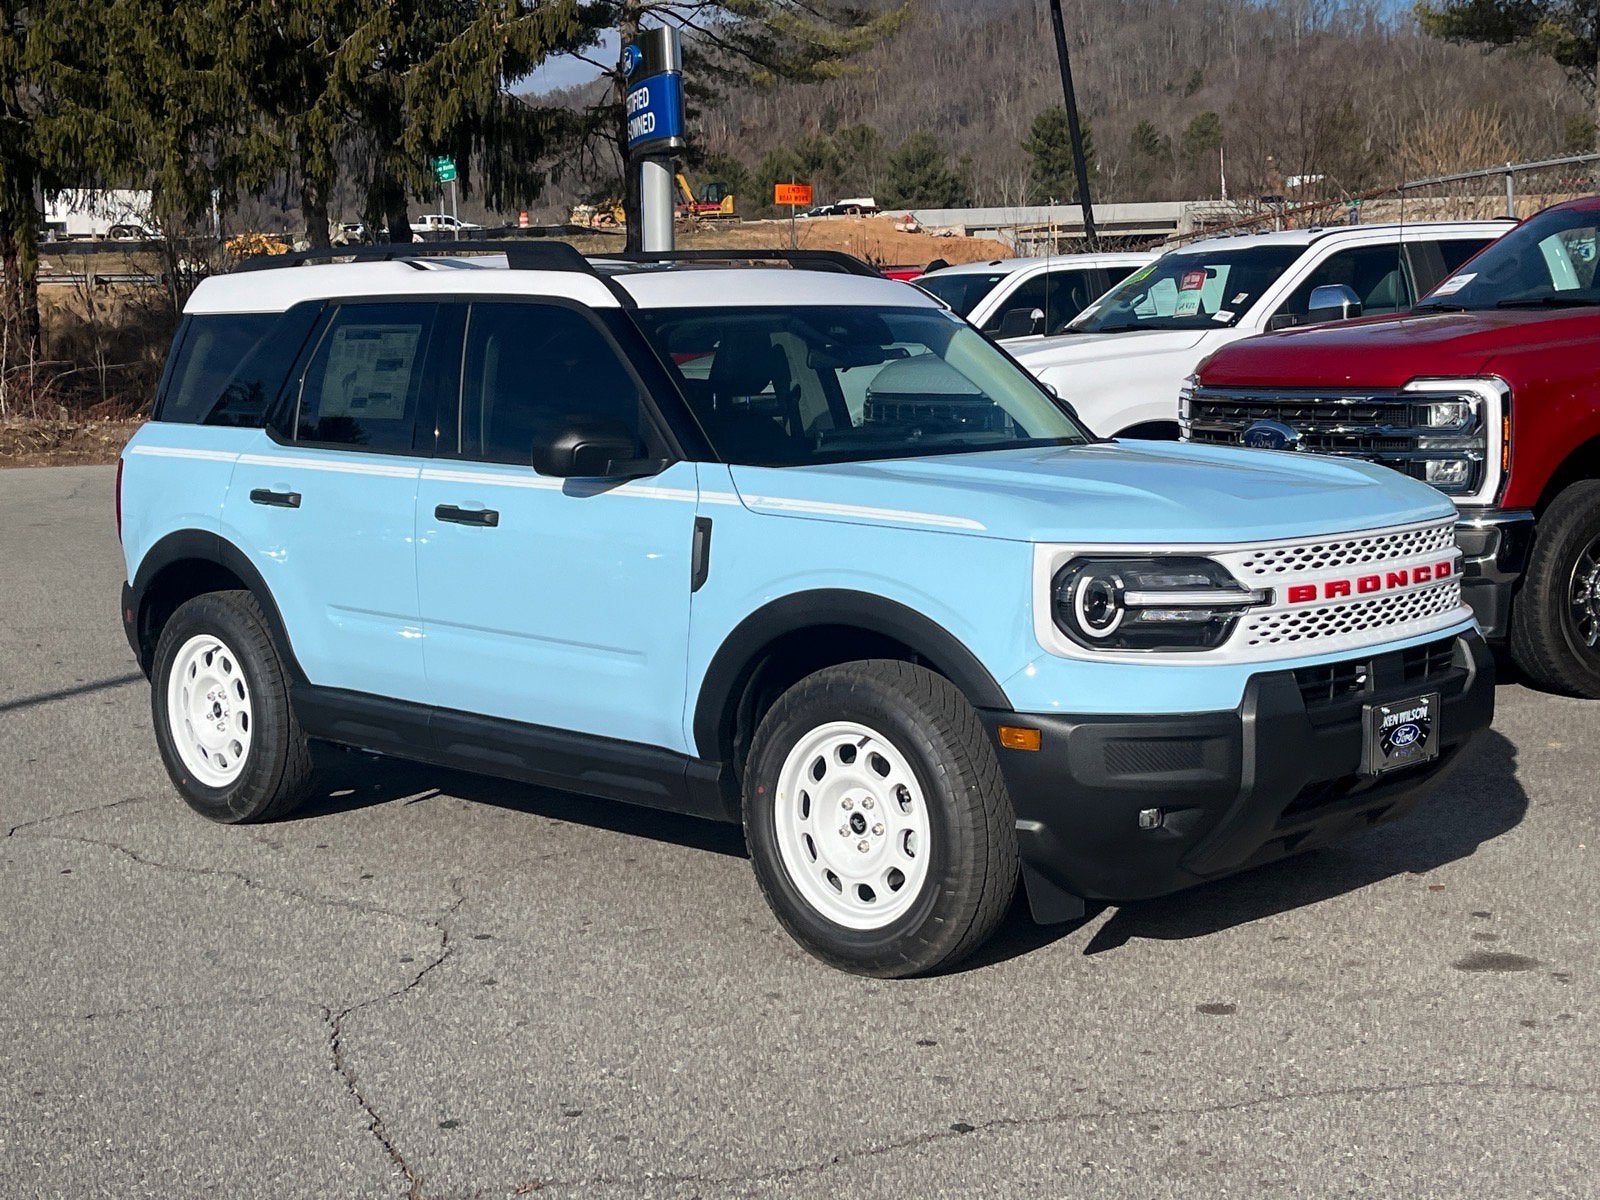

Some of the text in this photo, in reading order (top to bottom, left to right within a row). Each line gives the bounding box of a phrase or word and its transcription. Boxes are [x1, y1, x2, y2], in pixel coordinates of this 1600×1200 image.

[1288, 561, 1451, 603] BRONCO
[1383, 706, 1428, 728] KEN WILSON
[1395, 727, 1415, 744] Ford
